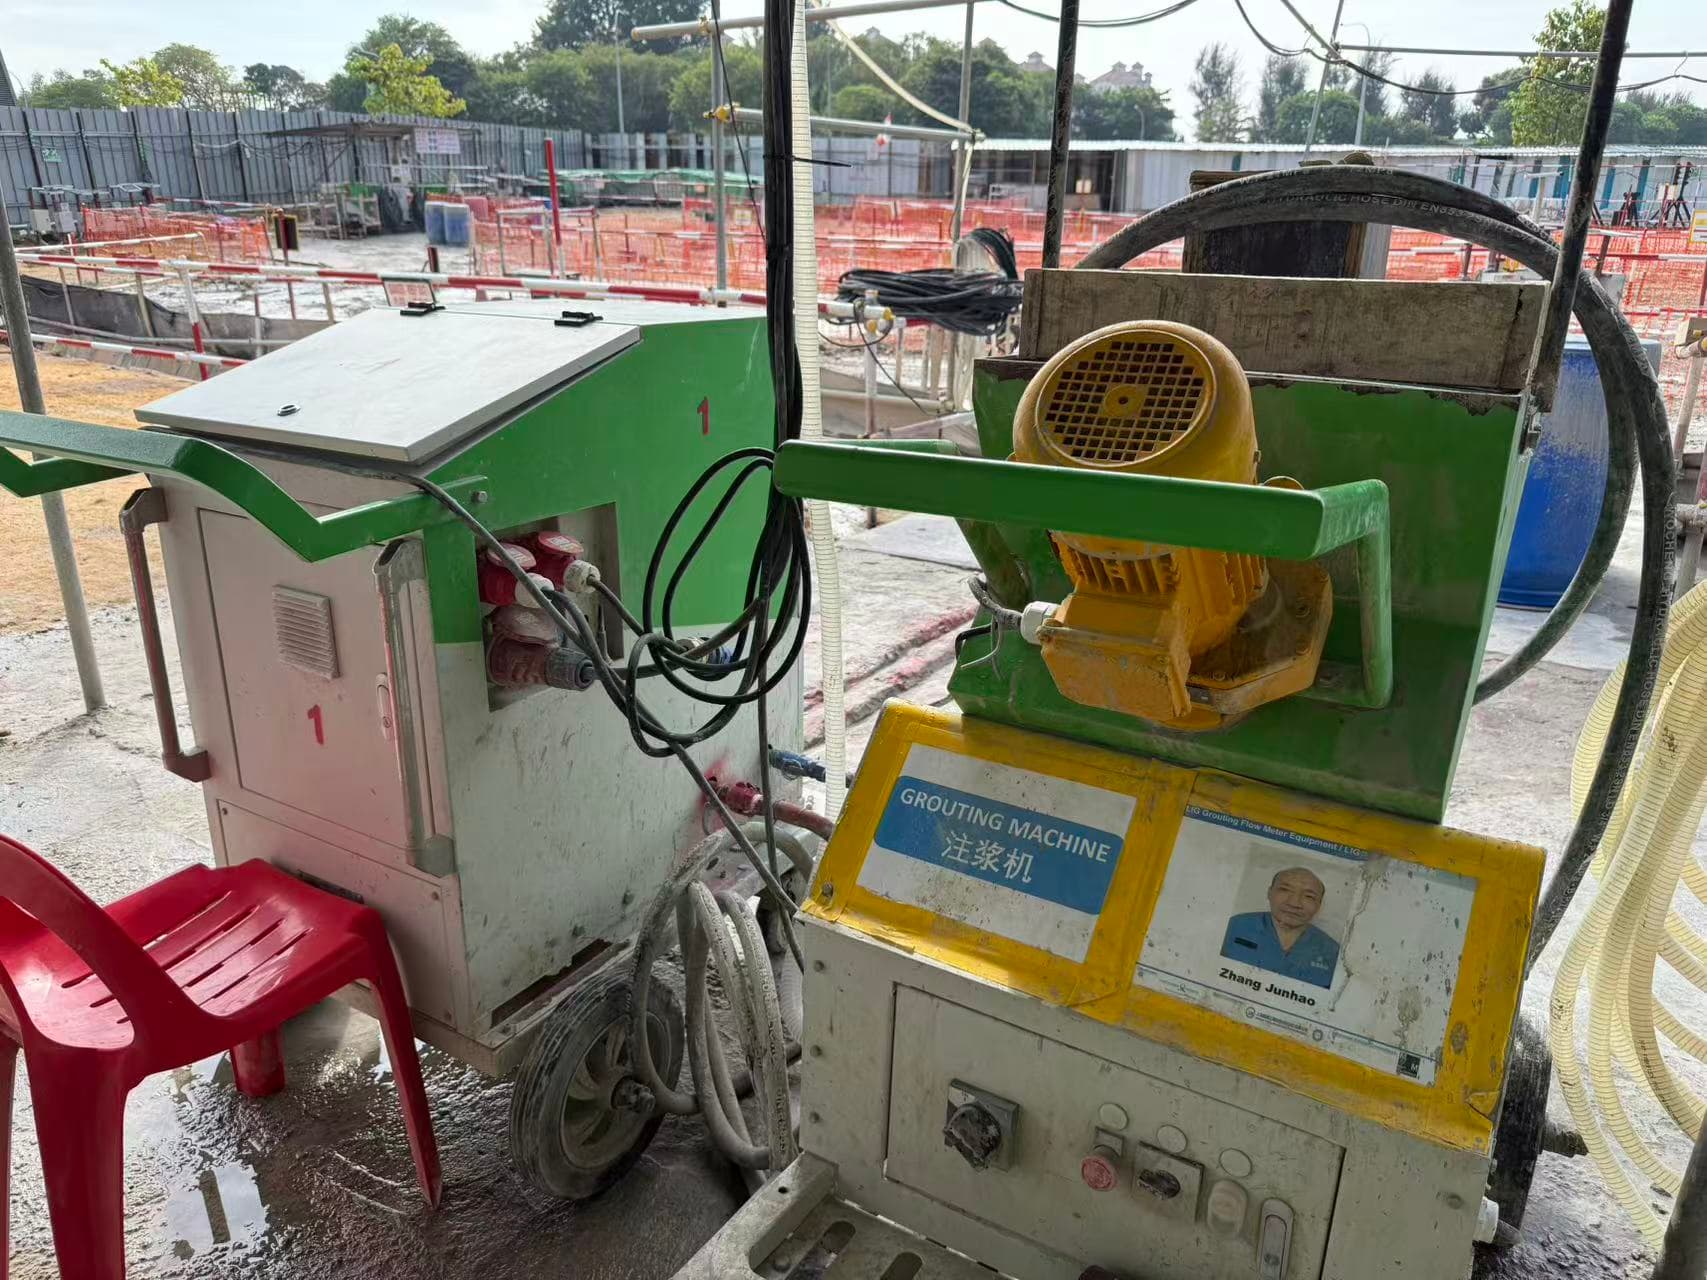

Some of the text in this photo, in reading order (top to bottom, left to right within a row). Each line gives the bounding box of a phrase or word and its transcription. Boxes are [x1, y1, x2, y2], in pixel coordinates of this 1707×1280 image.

[1350, 194, 1389, 206] HOSE
[1393, 197, 1417, 210] DIN
[696, 396, 710, 435] 1
[1637, 670, 1659, 708] HOSE
[306, 703, 325, 746] 1
[900, 788, 1112, 864] GROUTING MACHINE
[1202, 808, 1240, 826] Grouting
[1240, 818, 1262, 831] Flow
[1262, 825, 1289, 838] Meter
[1289, 831, 1339, 851] Equipment
[940, 831, 1035, 883] 注浆机
[1218, 967, 1262, 992] Zhang
[1265, 983, 1316, 1007] Junhao
